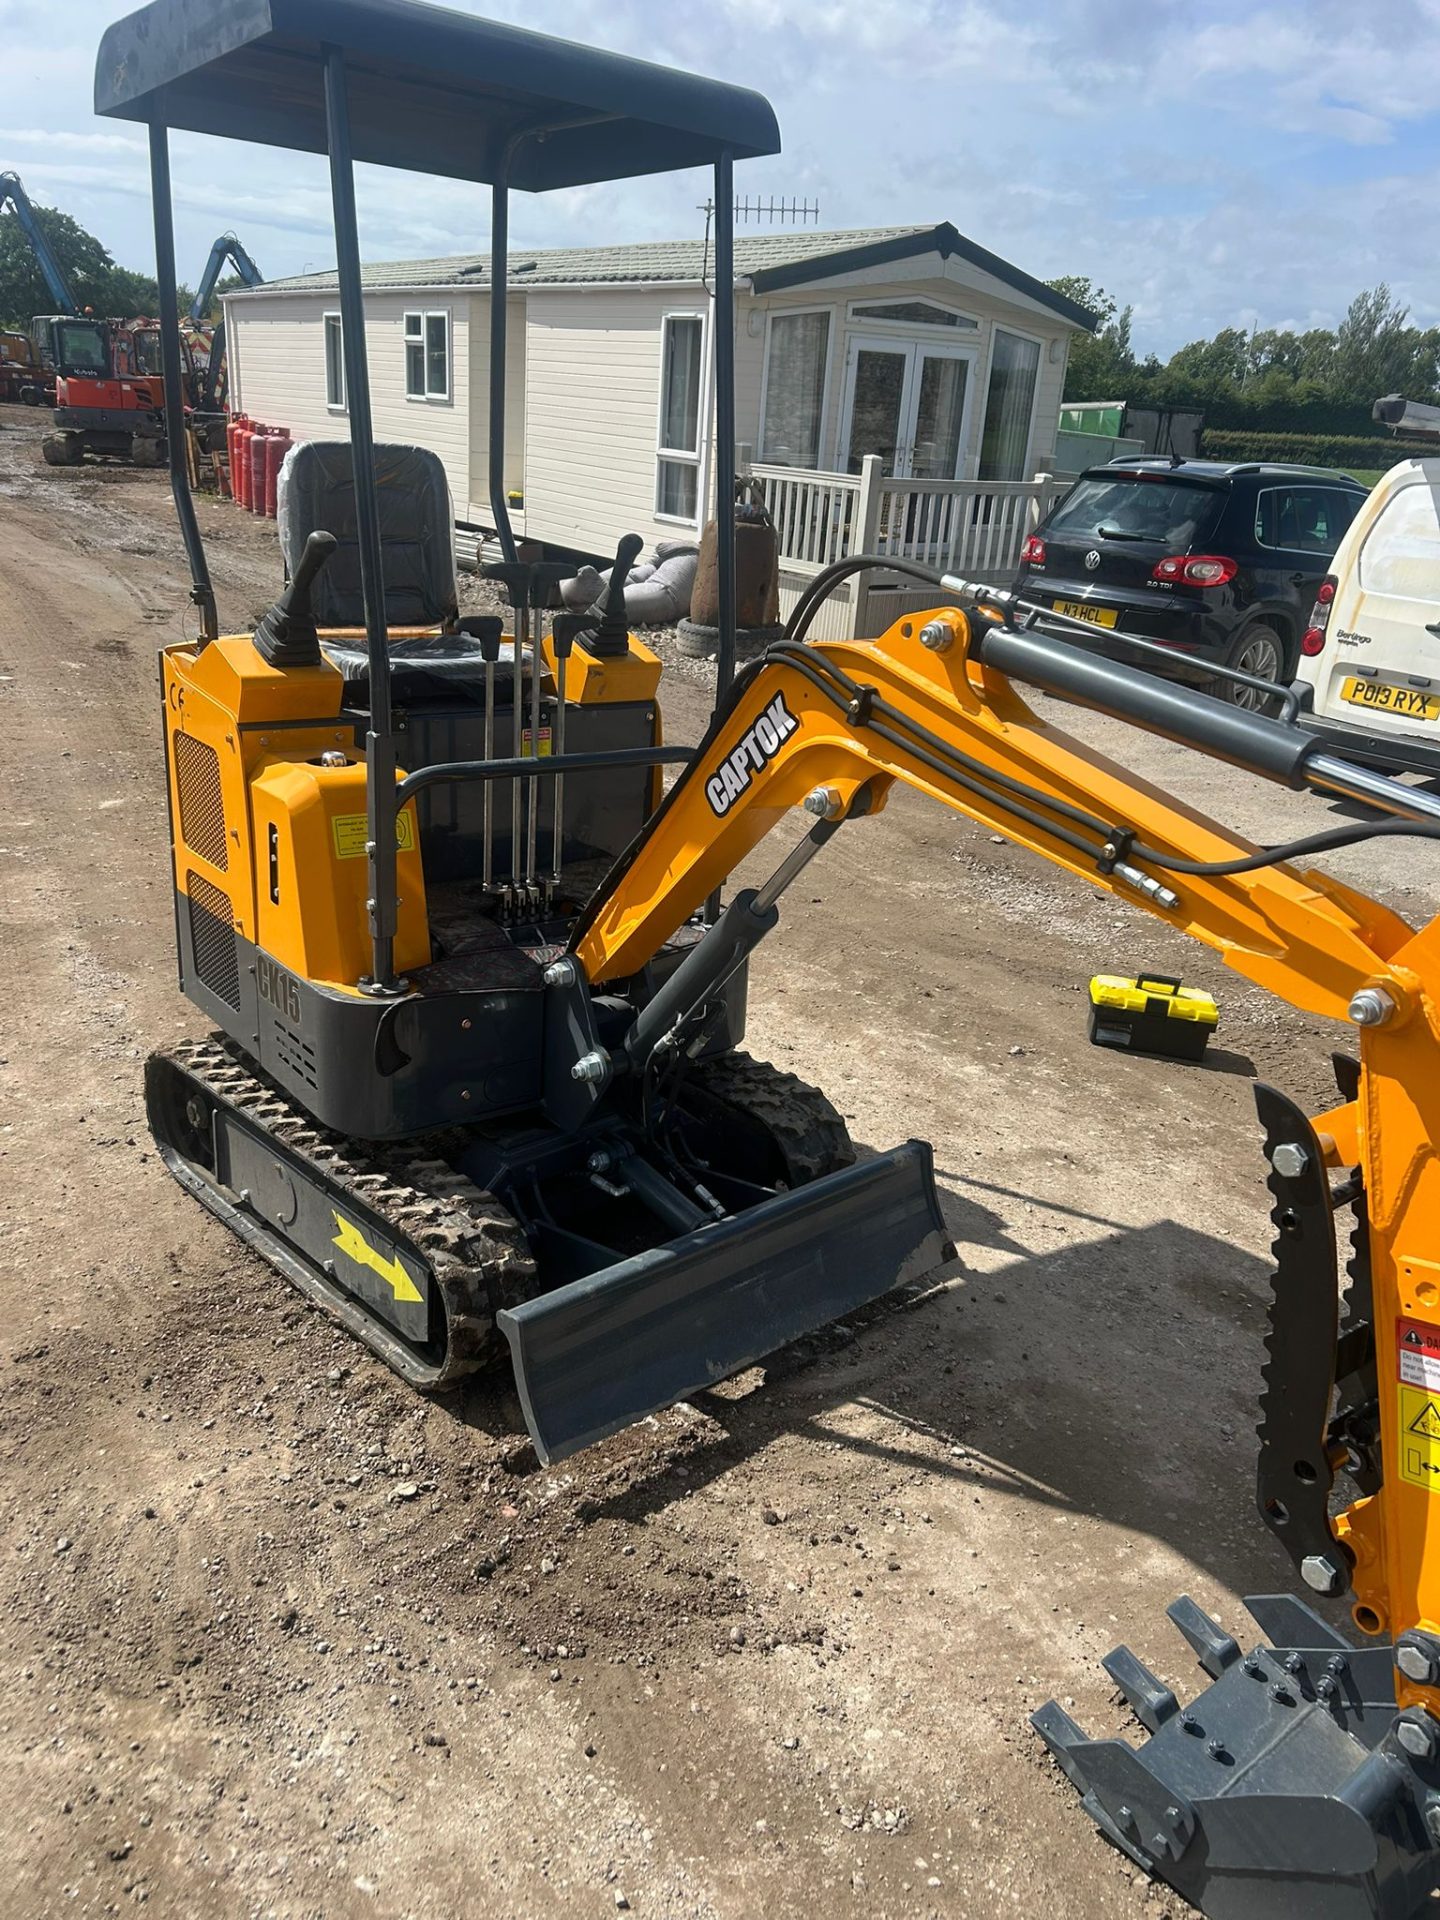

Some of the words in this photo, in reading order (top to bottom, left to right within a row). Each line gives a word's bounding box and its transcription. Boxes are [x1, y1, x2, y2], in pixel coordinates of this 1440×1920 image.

[1063, 603, 1078, 617] N3
[1080, 605, 1102, 622] HCL
[1336, 629, 1372, 644] Berlingo
[1393, 690, 1432, 714] RYX
[706, 693, 798, 815] CAPTOK
[257, 954, 301, 1024] CK15
[1426, 1336, 1440, 1350] DA
